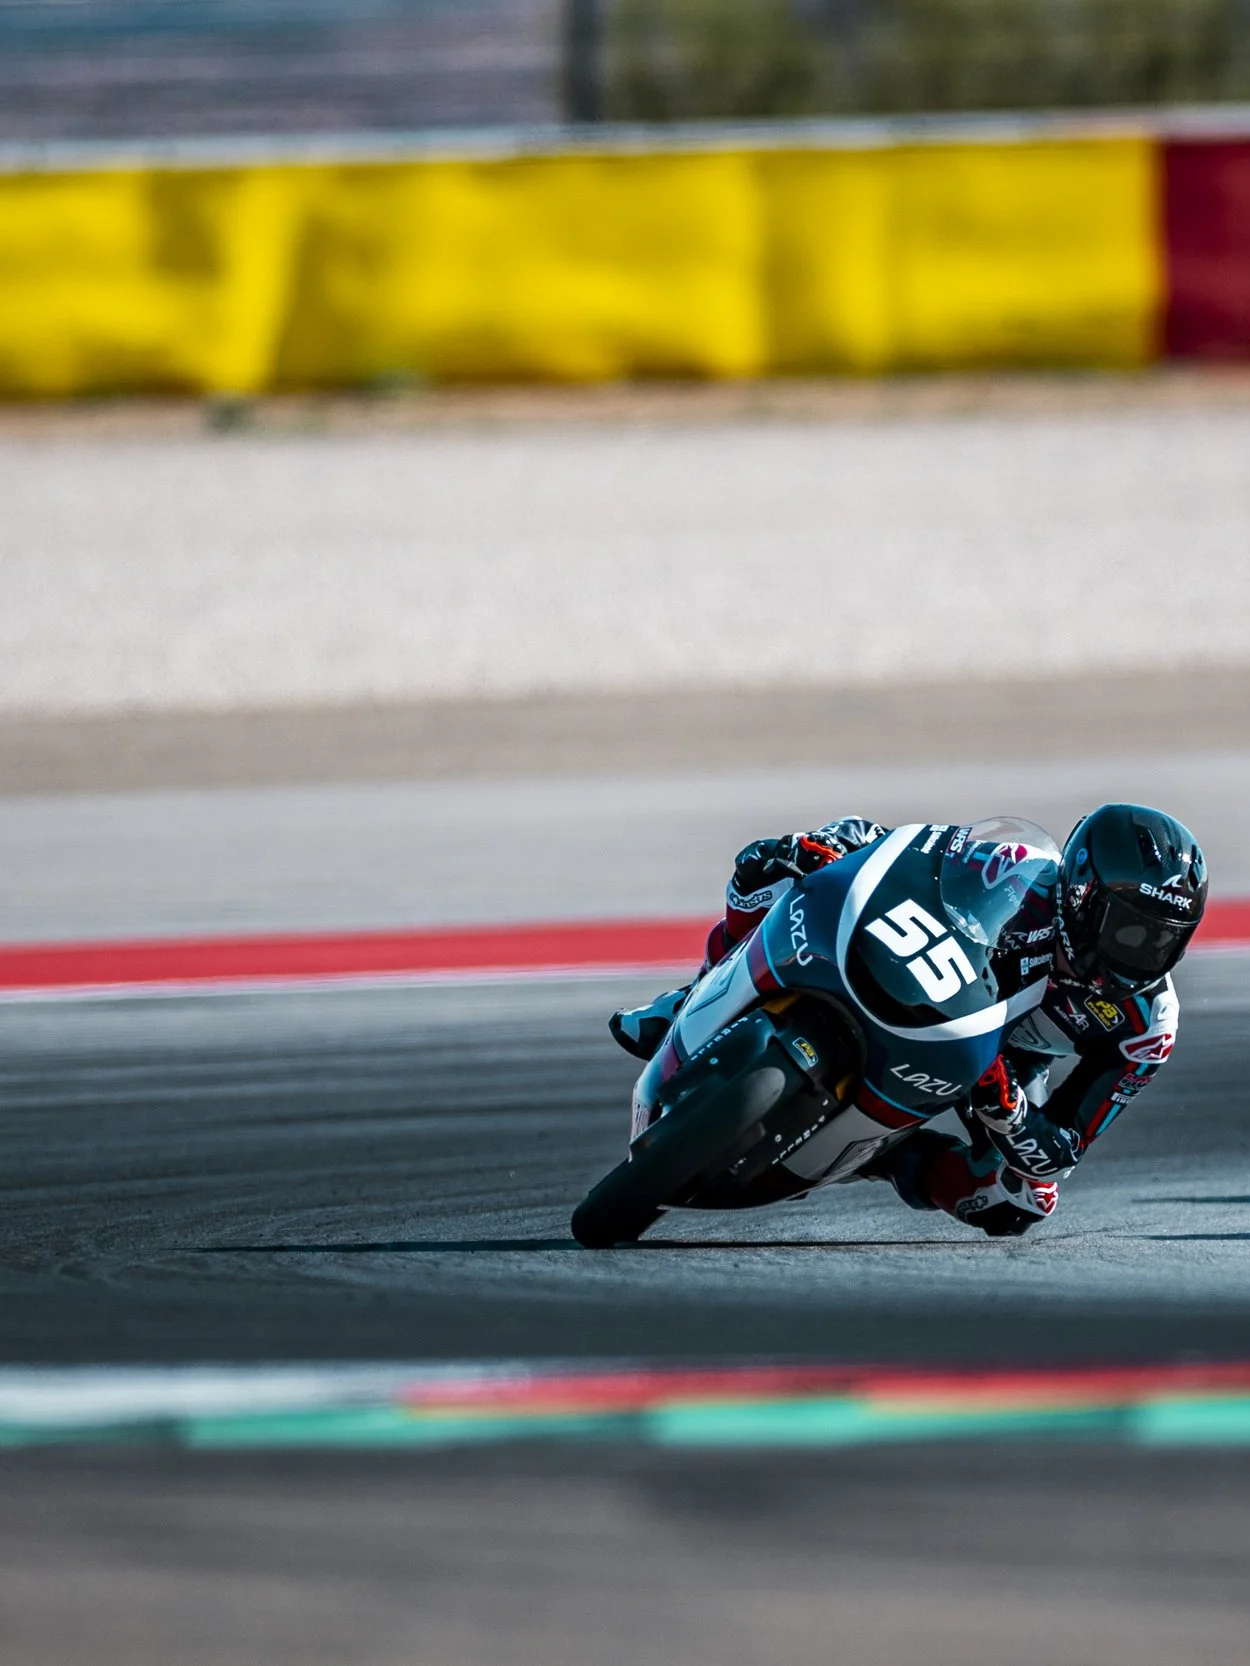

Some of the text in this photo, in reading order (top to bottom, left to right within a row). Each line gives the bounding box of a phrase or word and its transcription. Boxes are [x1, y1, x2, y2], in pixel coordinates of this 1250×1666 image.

[950, 828, 972, 853] WRS
[1139, 883, 1192, 910] SHARK
[789, 893, 814, 967] LAZU
[864, 898, 978, 1003] 55
[1095, 1000, 1118, 1019] PB
[690, 1017, 748, 1061] PIRELLI
[890, 1063, 962, 1096] LAZU
[771, 1115, 826, 1165] PIRELLI
[1006, 1126, 1058, 1175] LAZU
